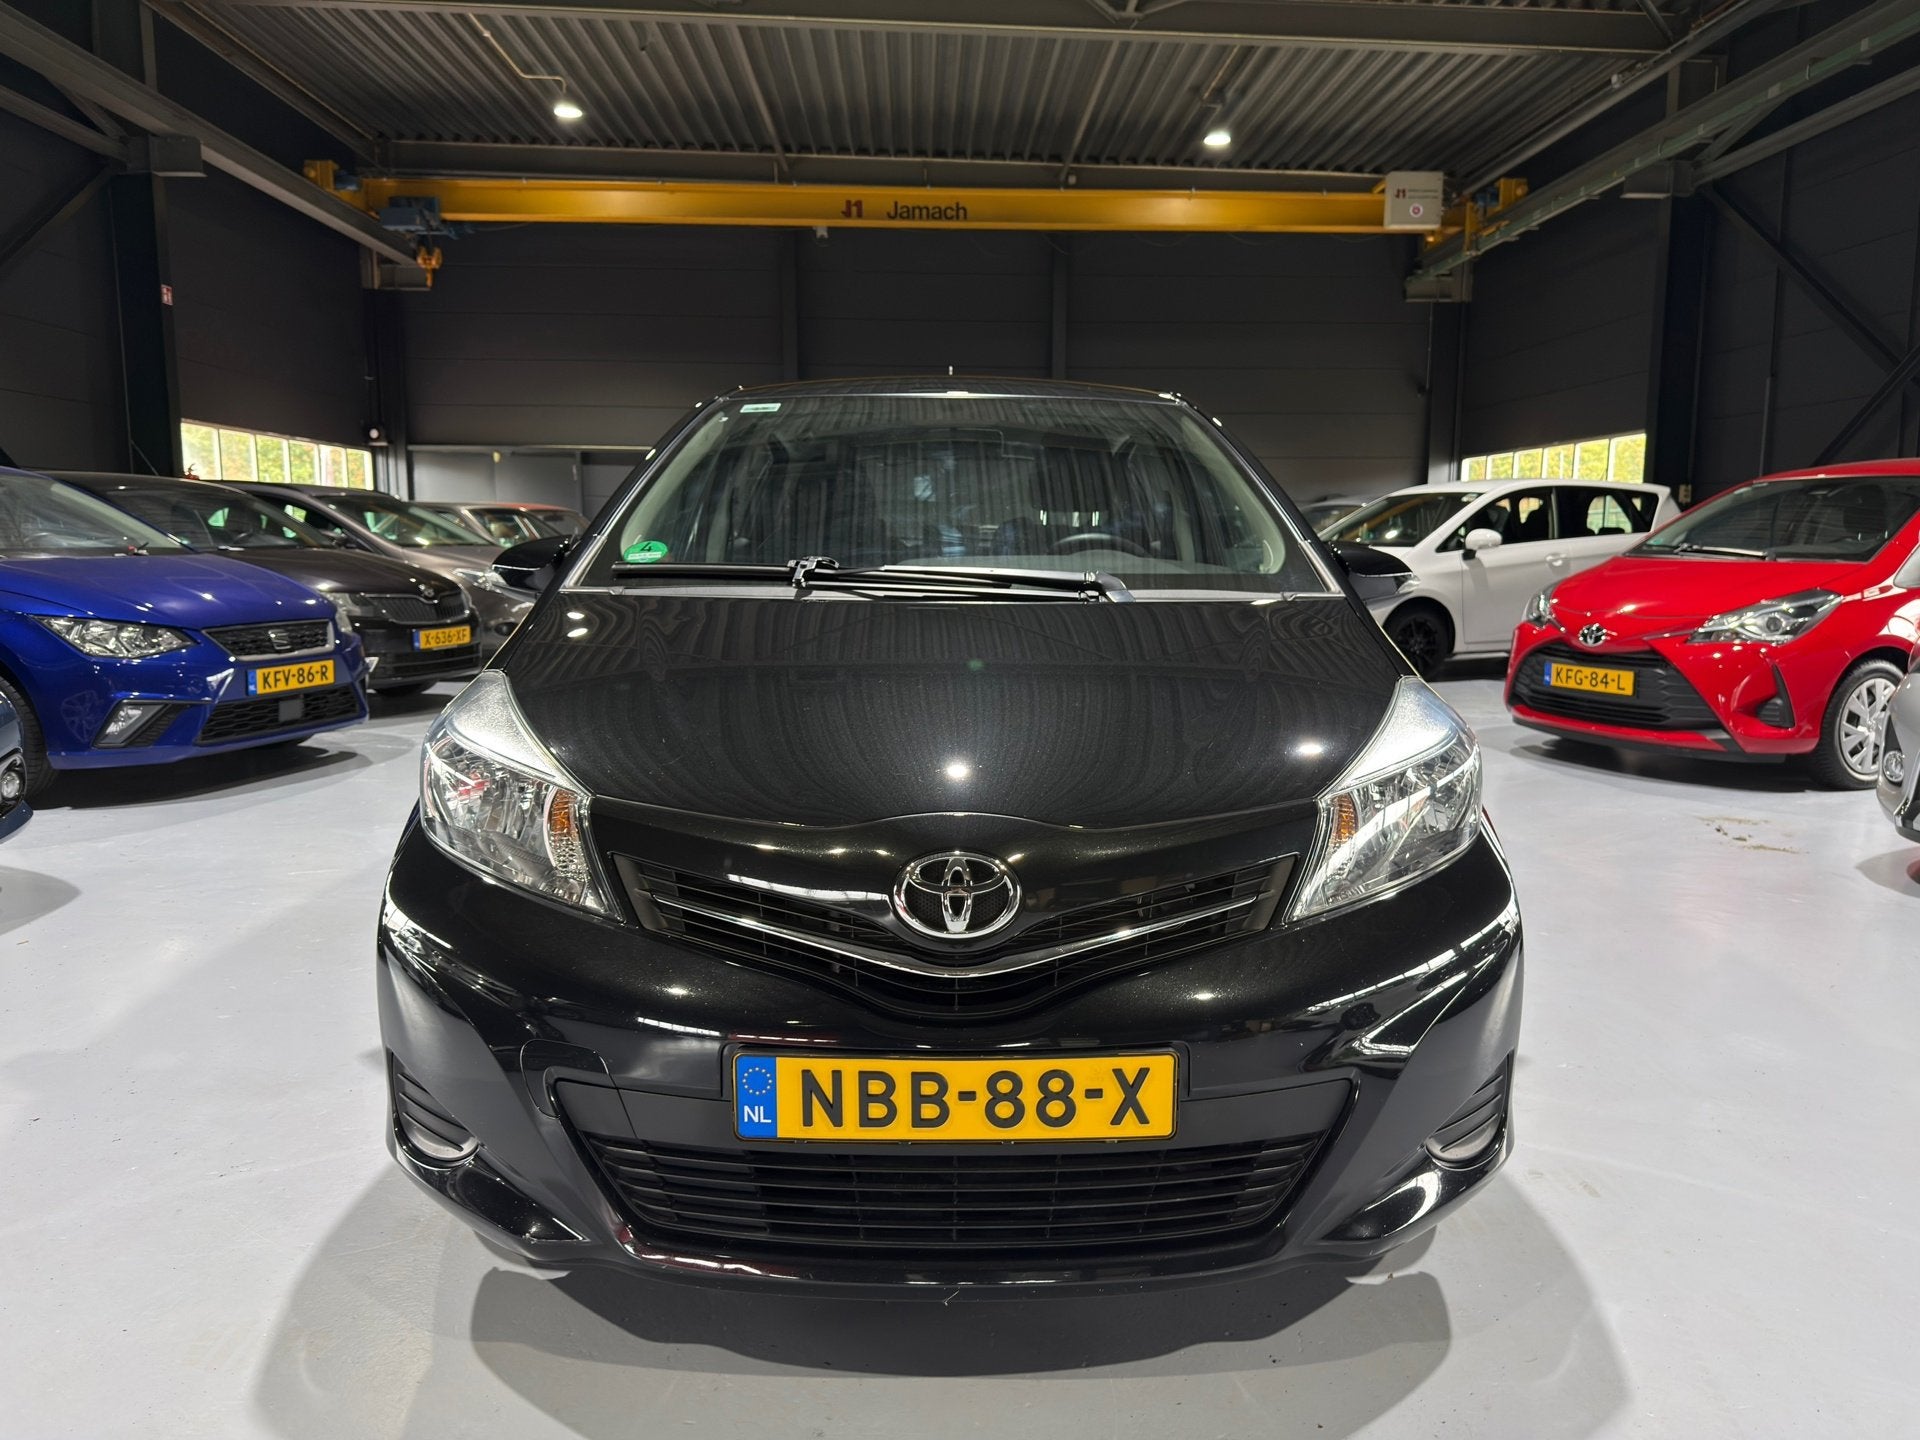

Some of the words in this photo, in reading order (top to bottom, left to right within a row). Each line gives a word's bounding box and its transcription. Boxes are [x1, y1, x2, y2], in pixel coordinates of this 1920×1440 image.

[887, 201, 968, 220] Jamach
[262, 664, 329, 689] KFV-86-R
[1555, 666, 1625, 691] KFG-84-L
[801, 1067, 1150, 1128] NBB-88-X
[744, 1105, 771, 1123] NL
